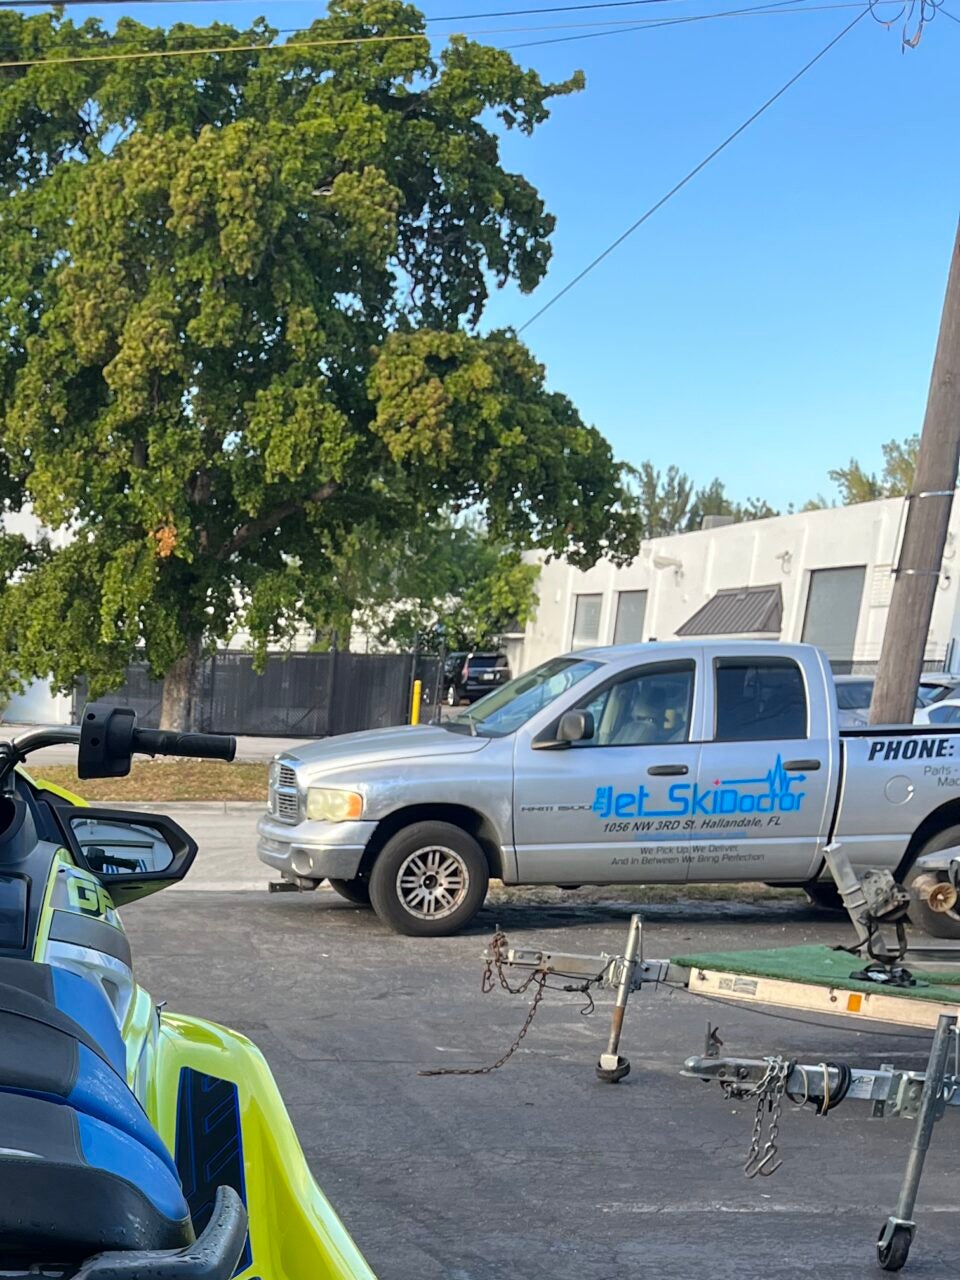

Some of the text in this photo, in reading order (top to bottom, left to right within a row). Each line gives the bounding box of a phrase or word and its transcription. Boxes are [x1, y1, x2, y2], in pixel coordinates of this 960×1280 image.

[868, 739, 955, 761] PHONE:
[603, 822, 630, 833] 1056
[632, 821, 654, 832] NW
[655, 820, 680, 831] 3RD
[766, 816, 782, 826] FL
